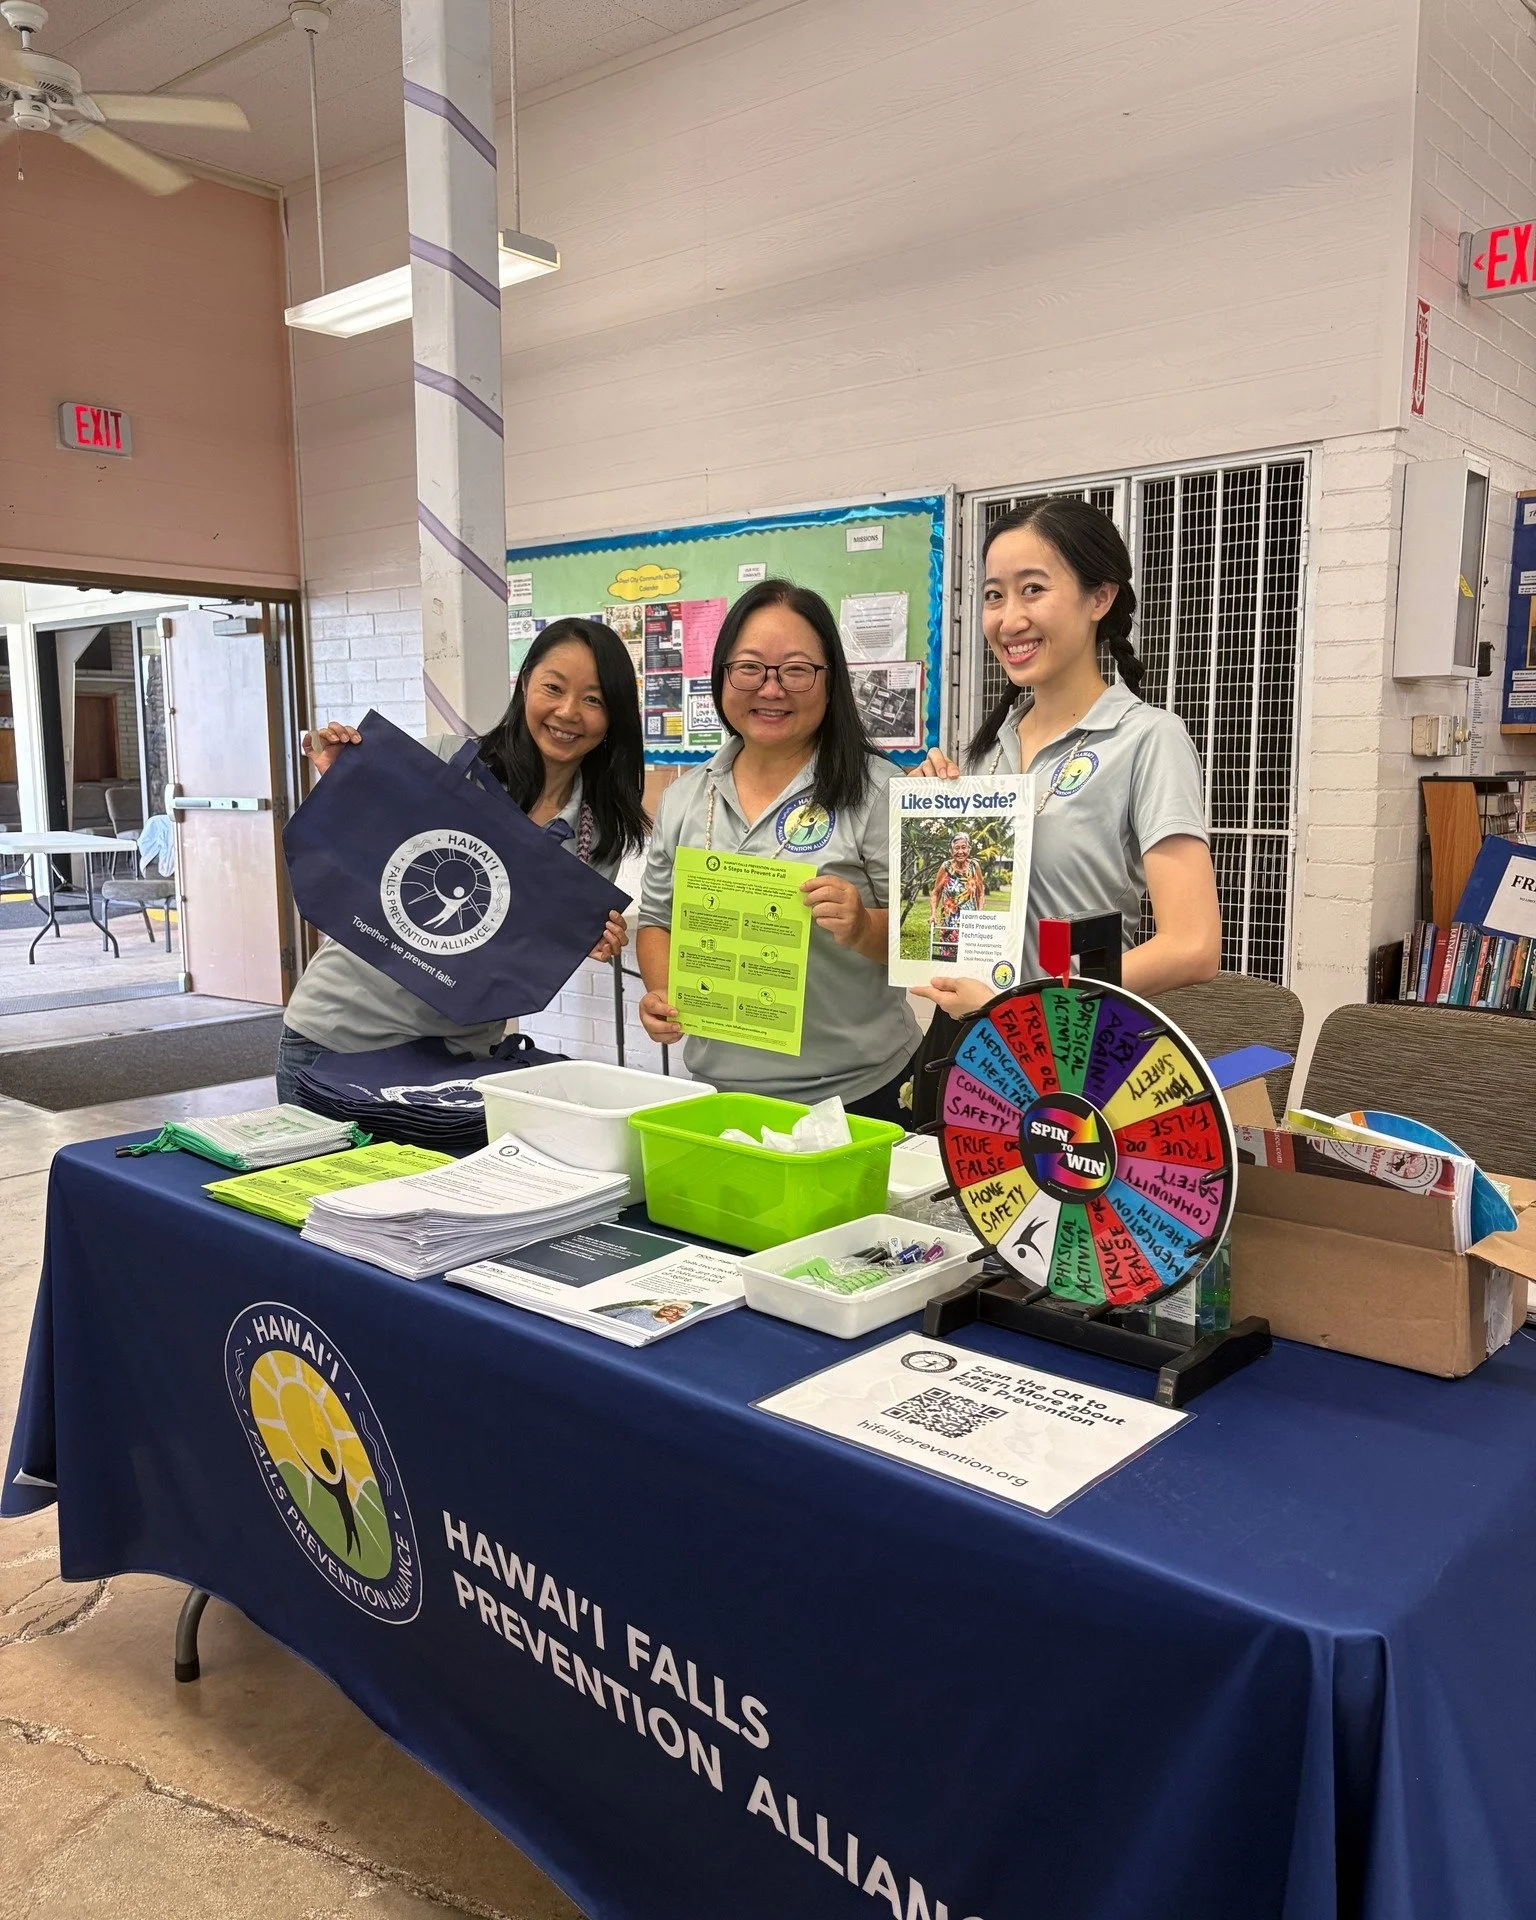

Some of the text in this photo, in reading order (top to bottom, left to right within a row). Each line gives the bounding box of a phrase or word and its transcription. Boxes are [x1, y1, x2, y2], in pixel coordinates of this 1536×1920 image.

[75, 404, 122, 450] EXIT
[853, 534, 878, 544] MISSIONS
[640, 574, 664, 582] Community
[901, 792, 1017, 814] Like Stay Safe?
[728, 866, 743, 874] Steps
[751, 869, 771, 877] Prevent
[1511, 874, 1536, 892] FR
[385, 865, 491, 950] FALLS PREVENTION ALLIANCE
[961, 922, 1007, 931] Falls Prevention
[352, 916, 458, 989] Together, we prevent falls!
[961, 932, 994, 941] Techniques
[741, 961, 746, 969] 4
[678, 992, 683, 1000] 5
[739, 1003, 744, 1011] 6
[998, 1008, 1034, 1064] FALSE
[1021, 1001, 1057, 1091] TRUE OR
[1052, 994, 1071, 1066] ACTIVITY
[962, 1045, 1028, 1109] & HEALTH
[976, 1026, 1034, 1104] MEDICATION
[1126, 1053, 1175, 1101] SAFETY
[947, 1096, 1010, 1132] SAFETY
[957, 1075, 1024, 1129] COMMUNITY
[1151, 1073, 1194, 1108] HOME
[951, 1134, 993, 1156] TRUE
[1030, 1121, 1070, 1143] SPIN
[1149, 1108, 1210, 1137] FALSE
[956, 1156, 1005, 1180] FALSE
[1061, 1142, 1074, 1152] TO
[1066, 1153, 1105, 1177] WIN
[1122, 1137, 1217, 1163] TRUE OR
[968, 1181, 1005, 1209] HOME
[981, 1184, 1027, 1233] SAFETY
[1124, 1165, 1211, 1226] COMMUNITY
[1154, 1165, 1219, 1206] SAFETY
[1090, 1197, 1128, 1297] TRUE OR
[1111, 1197, 1185, 1278] MEDICATION
[1137, 1204, 1184, 1248] HEALTH
[1053, 1218, 1077, 1289] PHYSICAL
[1075, 1225, 1097, 1299] ACTIVITY
[1109, 1225, 1154, 1288] FALSE
[253, 1314, 340, 1384] HAWAI'I
[948, 1376, 1099, 1428] Falls Prevention
[957, 1370, 1127, 1428] Learn More about
[969, 1364, 1109, 1411] Scan the QR to
[856, 1419, 1030, 1489] hifallsprevention.org
[249, 1427, 411, 1611] FALLS PREVENTION ALLIANCE
[442, 1510, 771, 1750] HAWAI'I FALLS
[452, 1570, 985, 1920] PREVENTION ALLIAN
